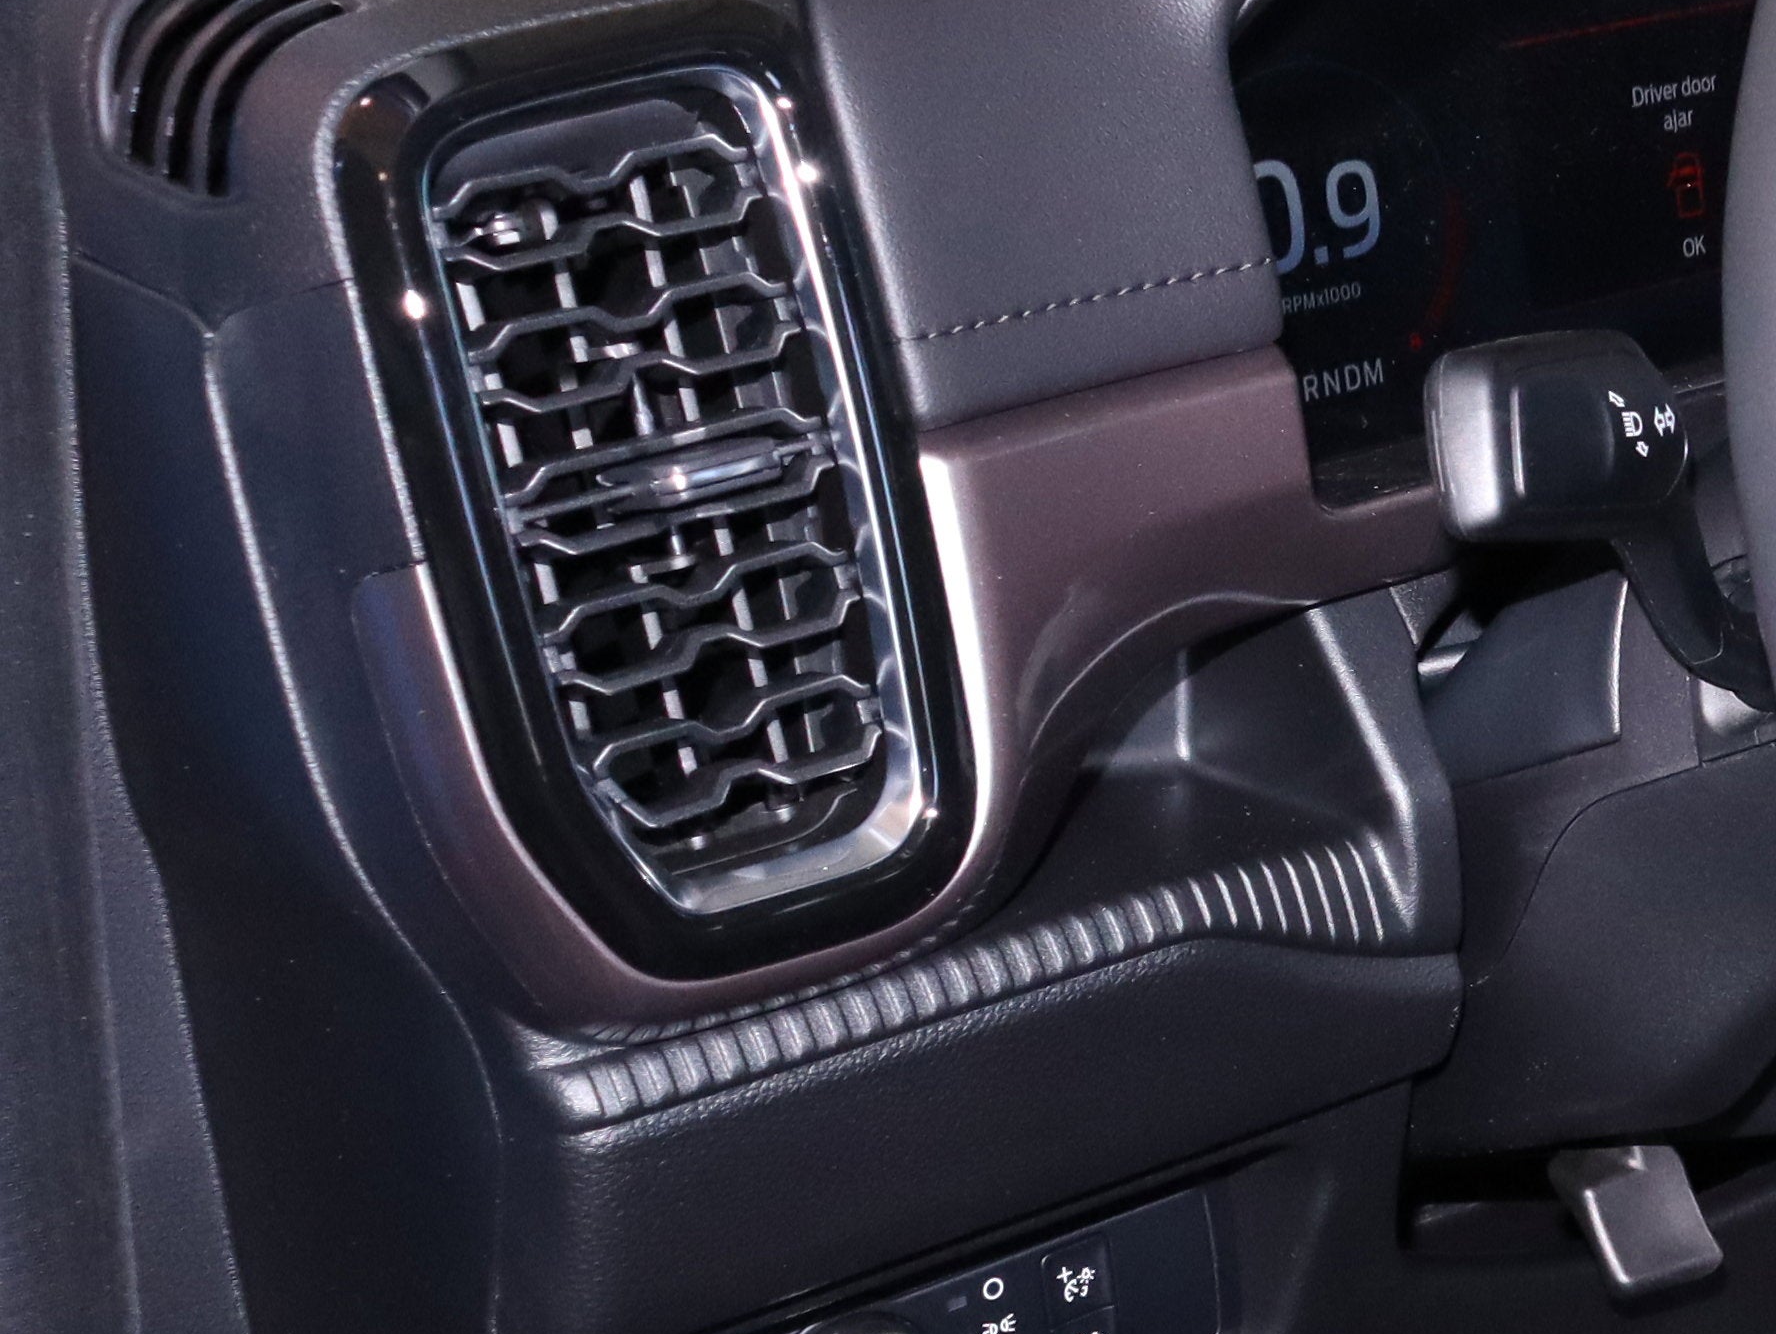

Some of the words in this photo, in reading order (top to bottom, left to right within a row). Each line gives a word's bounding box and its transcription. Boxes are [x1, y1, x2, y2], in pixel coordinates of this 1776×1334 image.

[1631, 82, 1678, 108] Driver
[1681, 74, 1717, 97] door
[1663, 108, 1693, 134] ajar
[1682, 234, 1707, 258] OK
